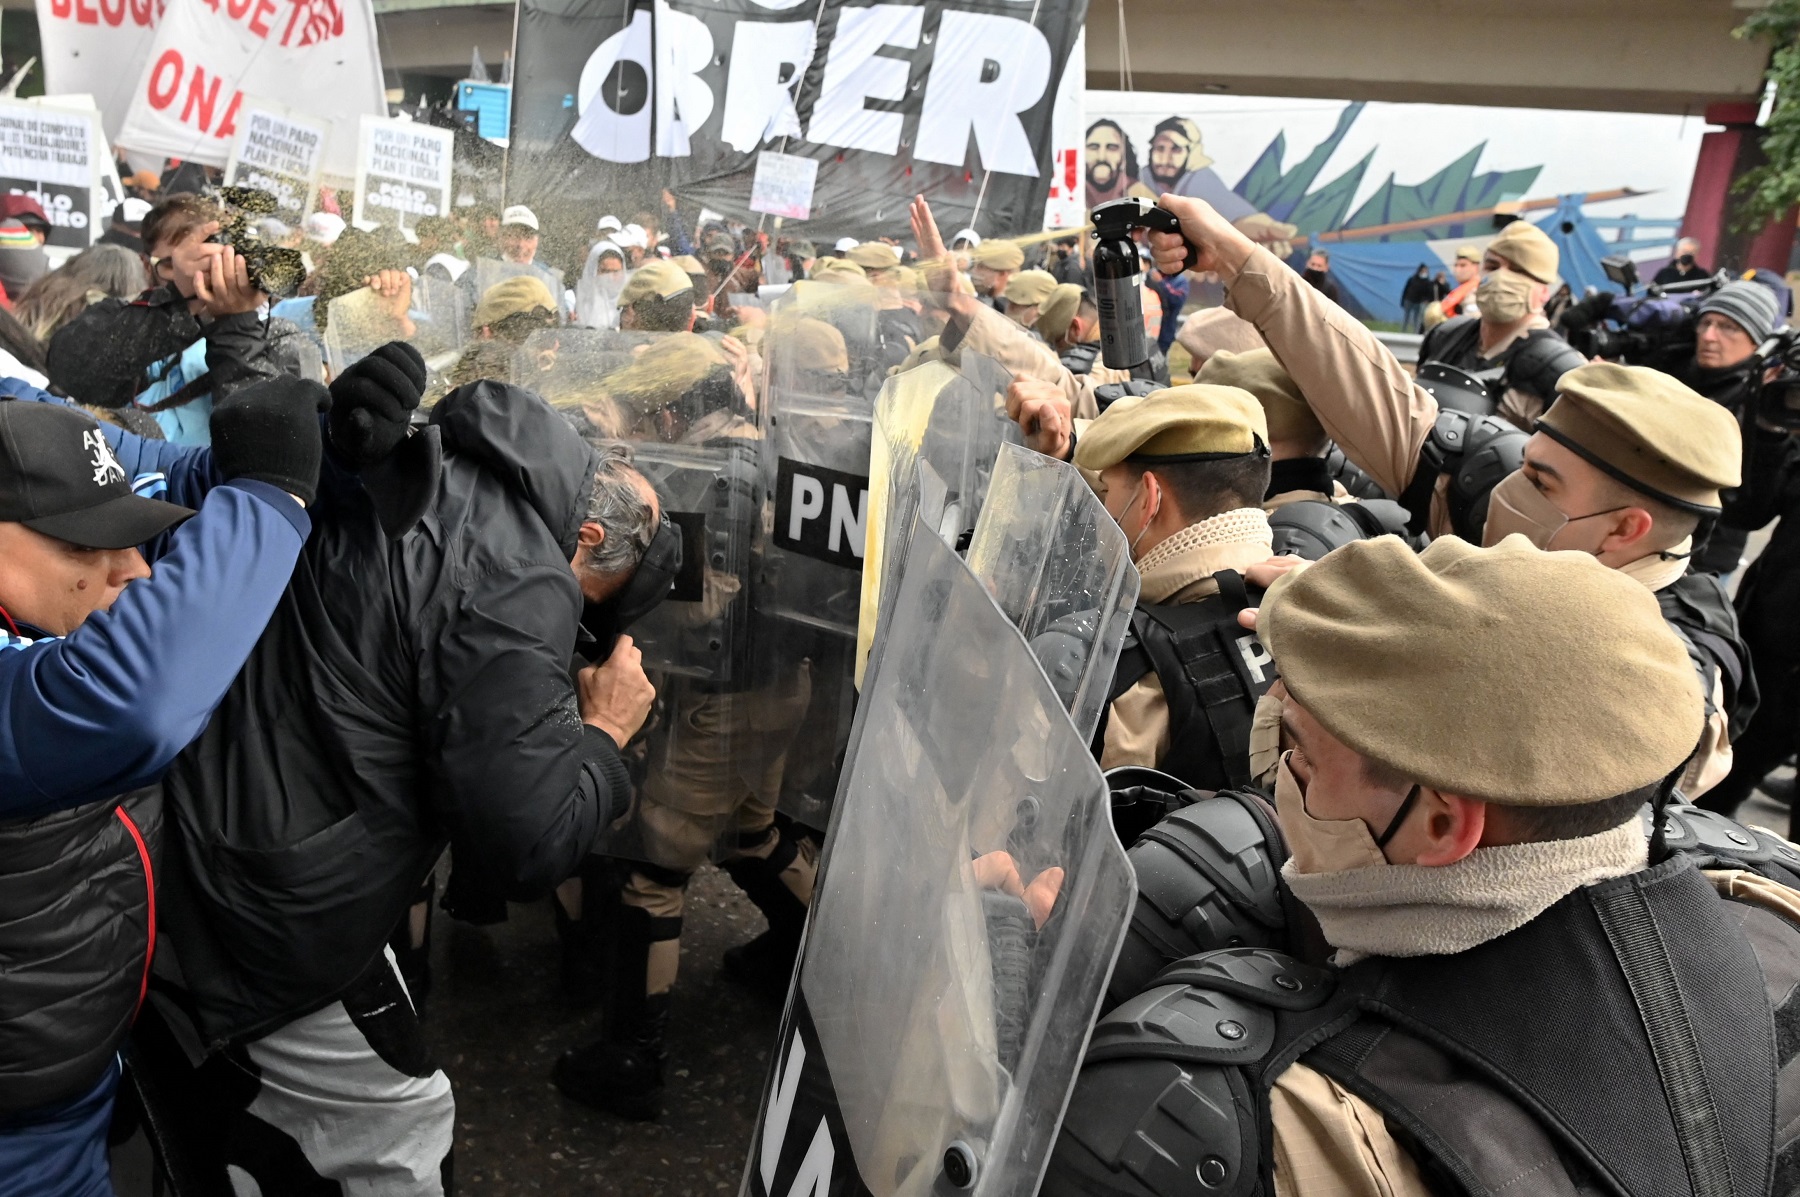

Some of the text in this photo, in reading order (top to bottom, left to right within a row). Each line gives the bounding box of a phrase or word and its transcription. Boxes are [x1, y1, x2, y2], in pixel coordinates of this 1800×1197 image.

[251, 114, 271, 131] POR
[289, 127, 318, 147] PARO
[374, 128, 394, 142] POR
[413, 135, 442, 152] PARO
[249, 131, 304, 159] NACIONAL
[374, 143, 430, 166] NACIONAL
[372, 157, 396, 173] PLAN
[367, 191, 437, 216] OBRERO
[379, 182, 427, 204] POLO
